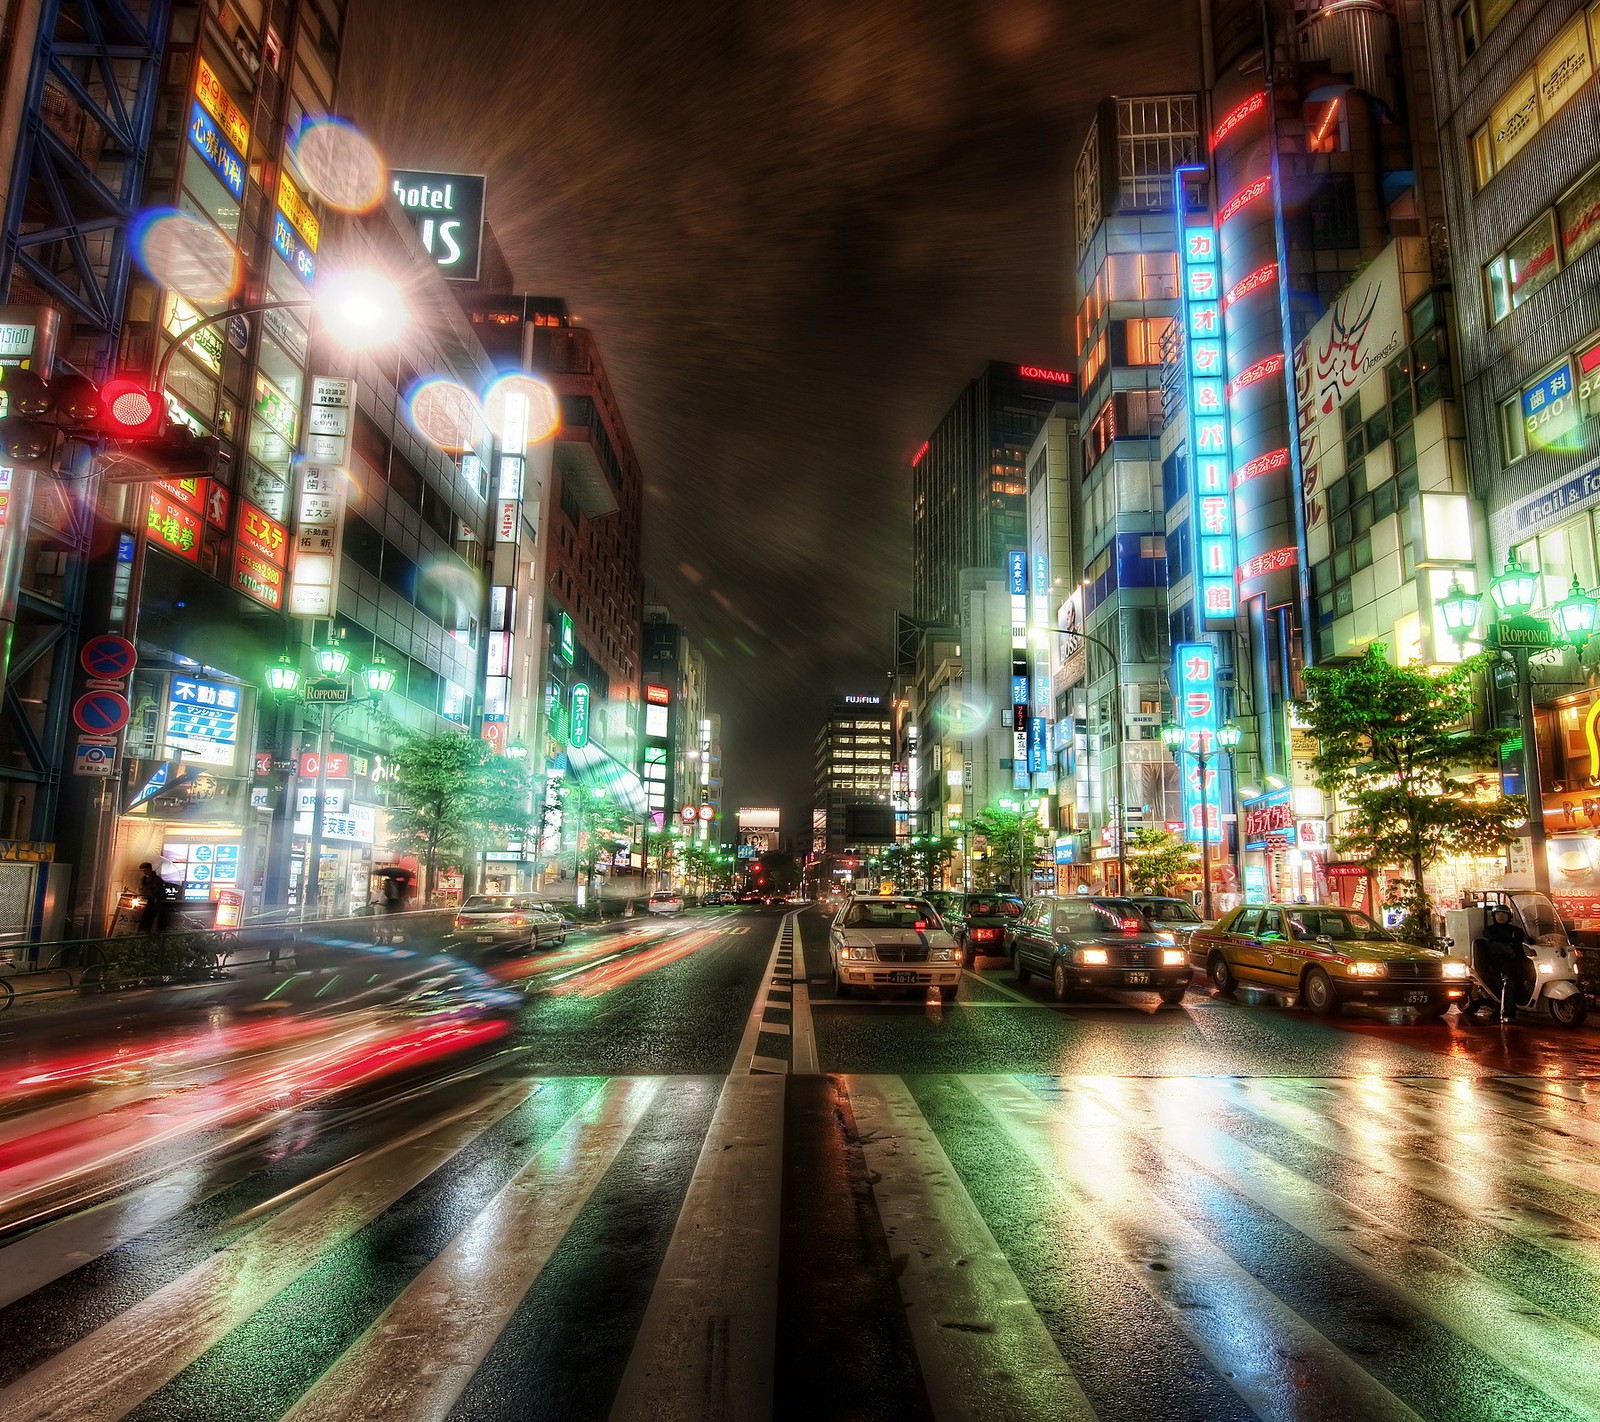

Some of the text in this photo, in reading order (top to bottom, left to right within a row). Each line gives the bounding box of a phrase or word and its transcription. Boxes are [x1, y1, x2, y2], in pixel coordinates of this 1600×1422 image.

[193, 116, 242, 191] 心療内科
[393, 180, 453, 210] hotel
[275, 221, 296, 261] 内科
[1020, 365, 1070, 384] KONAMI
[1529, 372, 1567, 411] 歯科
[1190, 235, 1233, 609] カラオケ&パーティー館
[1294, 339, 1325, 532] オリエンタル
[305, 508, 332, 518] エステ
[310, 500, 330, 508] 中国
[1529, 489, 1565, 525] nail
[245, 511, 283, 550] エステ
[304, 528, 330, 537] 不動産
[500, 503, 514, 538] Kelly
[1500, 624, 1549, 644] ROPPONGI
[175, 682, 236, 708] 不動産
[306, 686, 346, 701] ROPPONGI
[845, 695, 880, 704] FUJIFILM
[187, 706, 223, 717] マンション
[574, 696, 586, 743] モスバーガー
[1032, 718, 1042, 771] スペーストラスト
[1185, 656, 1218, 830] カラオケ館
[302, 796, 339, 806] DRGS
[1292, 948, 1308, 957] TAXI
[1129, 976, 1149, 984] 28-77
[1408, 995, 1428, 1004] 65-73
